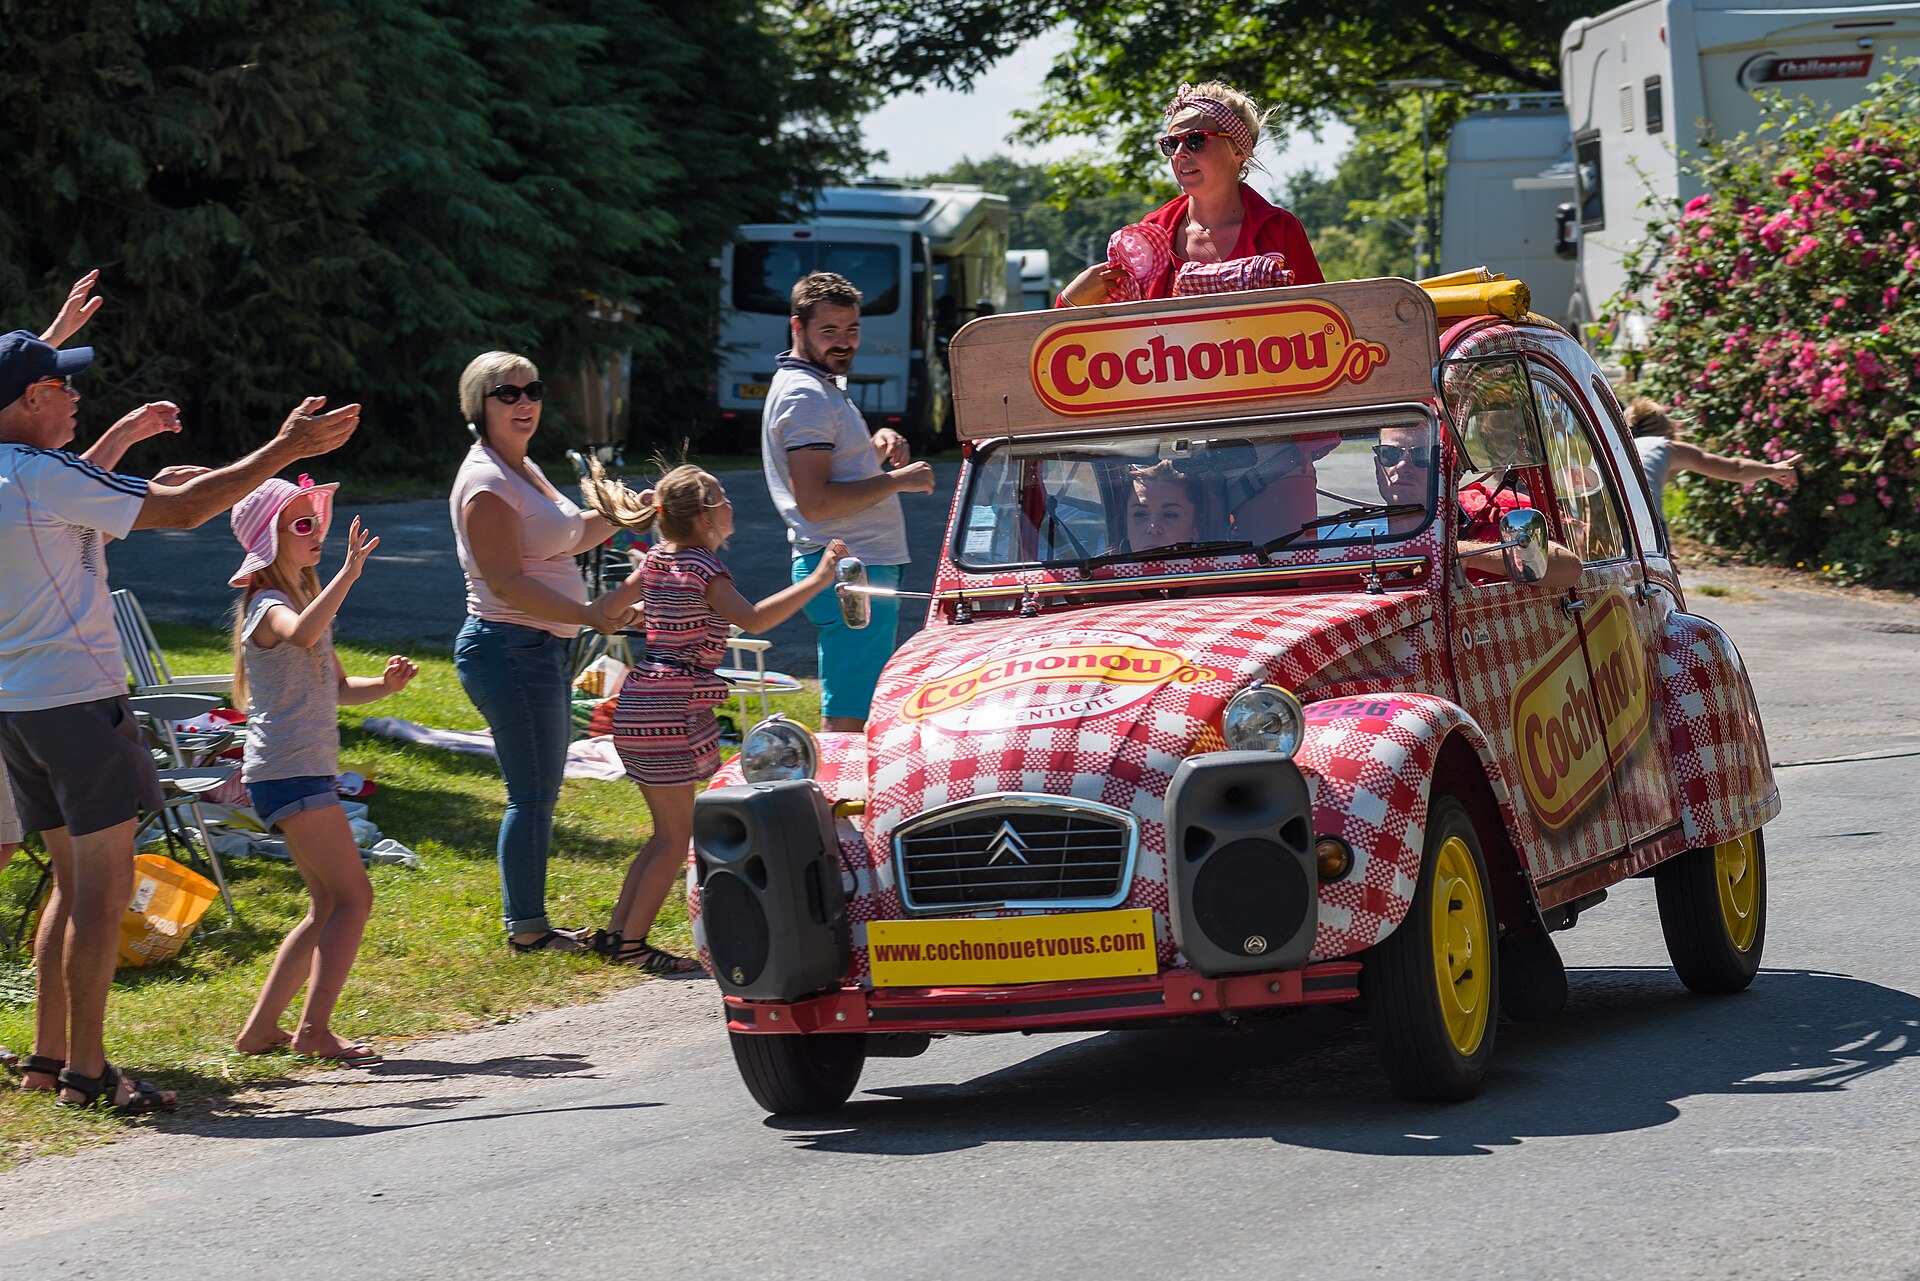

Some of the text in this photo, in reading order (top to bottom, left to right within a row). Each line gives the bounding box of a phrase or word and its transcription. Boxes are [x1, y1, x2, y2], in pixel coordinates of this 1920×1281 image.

[1777, 60, 1865, 78] Challenger
[1050, 331, 1328, 396] Cochonou
[917, 654, 1161, 709] Cochonou
[959, 694, 1118, 726] AENTICITÉ
[874, 931, 1146, 962] www.cochonouetvous.com
